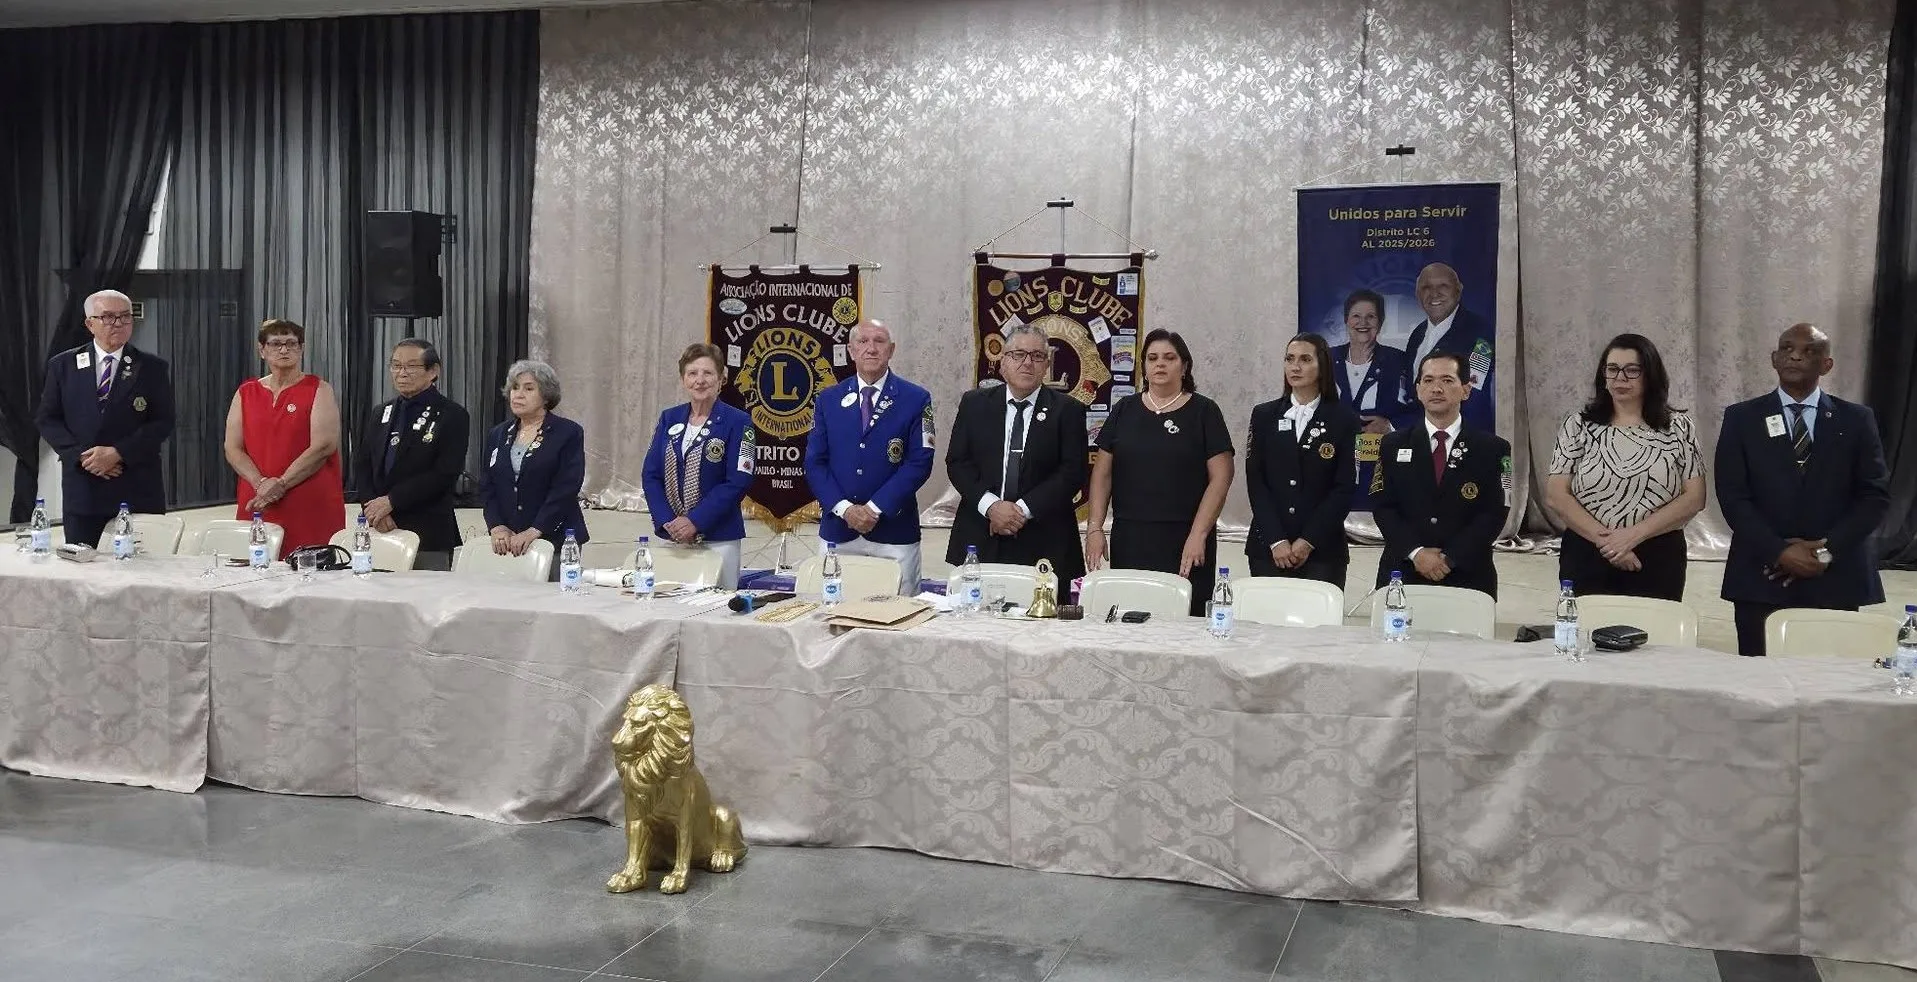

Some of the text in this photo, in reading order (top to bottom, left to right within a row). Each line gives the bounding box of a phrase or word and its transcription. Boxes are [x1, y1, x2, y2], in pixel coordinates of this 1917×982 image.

[1328, 204, 1468, 222] Unidos para Servir
[1366, 227, 1430, 237] Distrito LC 6
[1361, 238, 1437, 249] AL 2025/2026
[768, 282, 840, 298] INTERNACIONAL
[841, 282, 853, 297] DE
[988, 275, 1050, 327] LIONS
[1060, 275, 1134, 330] CLUBE
[724, 303, 777, 344] LIONS
[782, 303, 851, 344] CLUBE
[755, 330, 818, 356] LIONS
[770, 361, 799, 400] L
[755, 445, 801, 462] TRITO
[780, 466, 804, 477] MINAS
[771, 479, 794, 489] BRASIL
